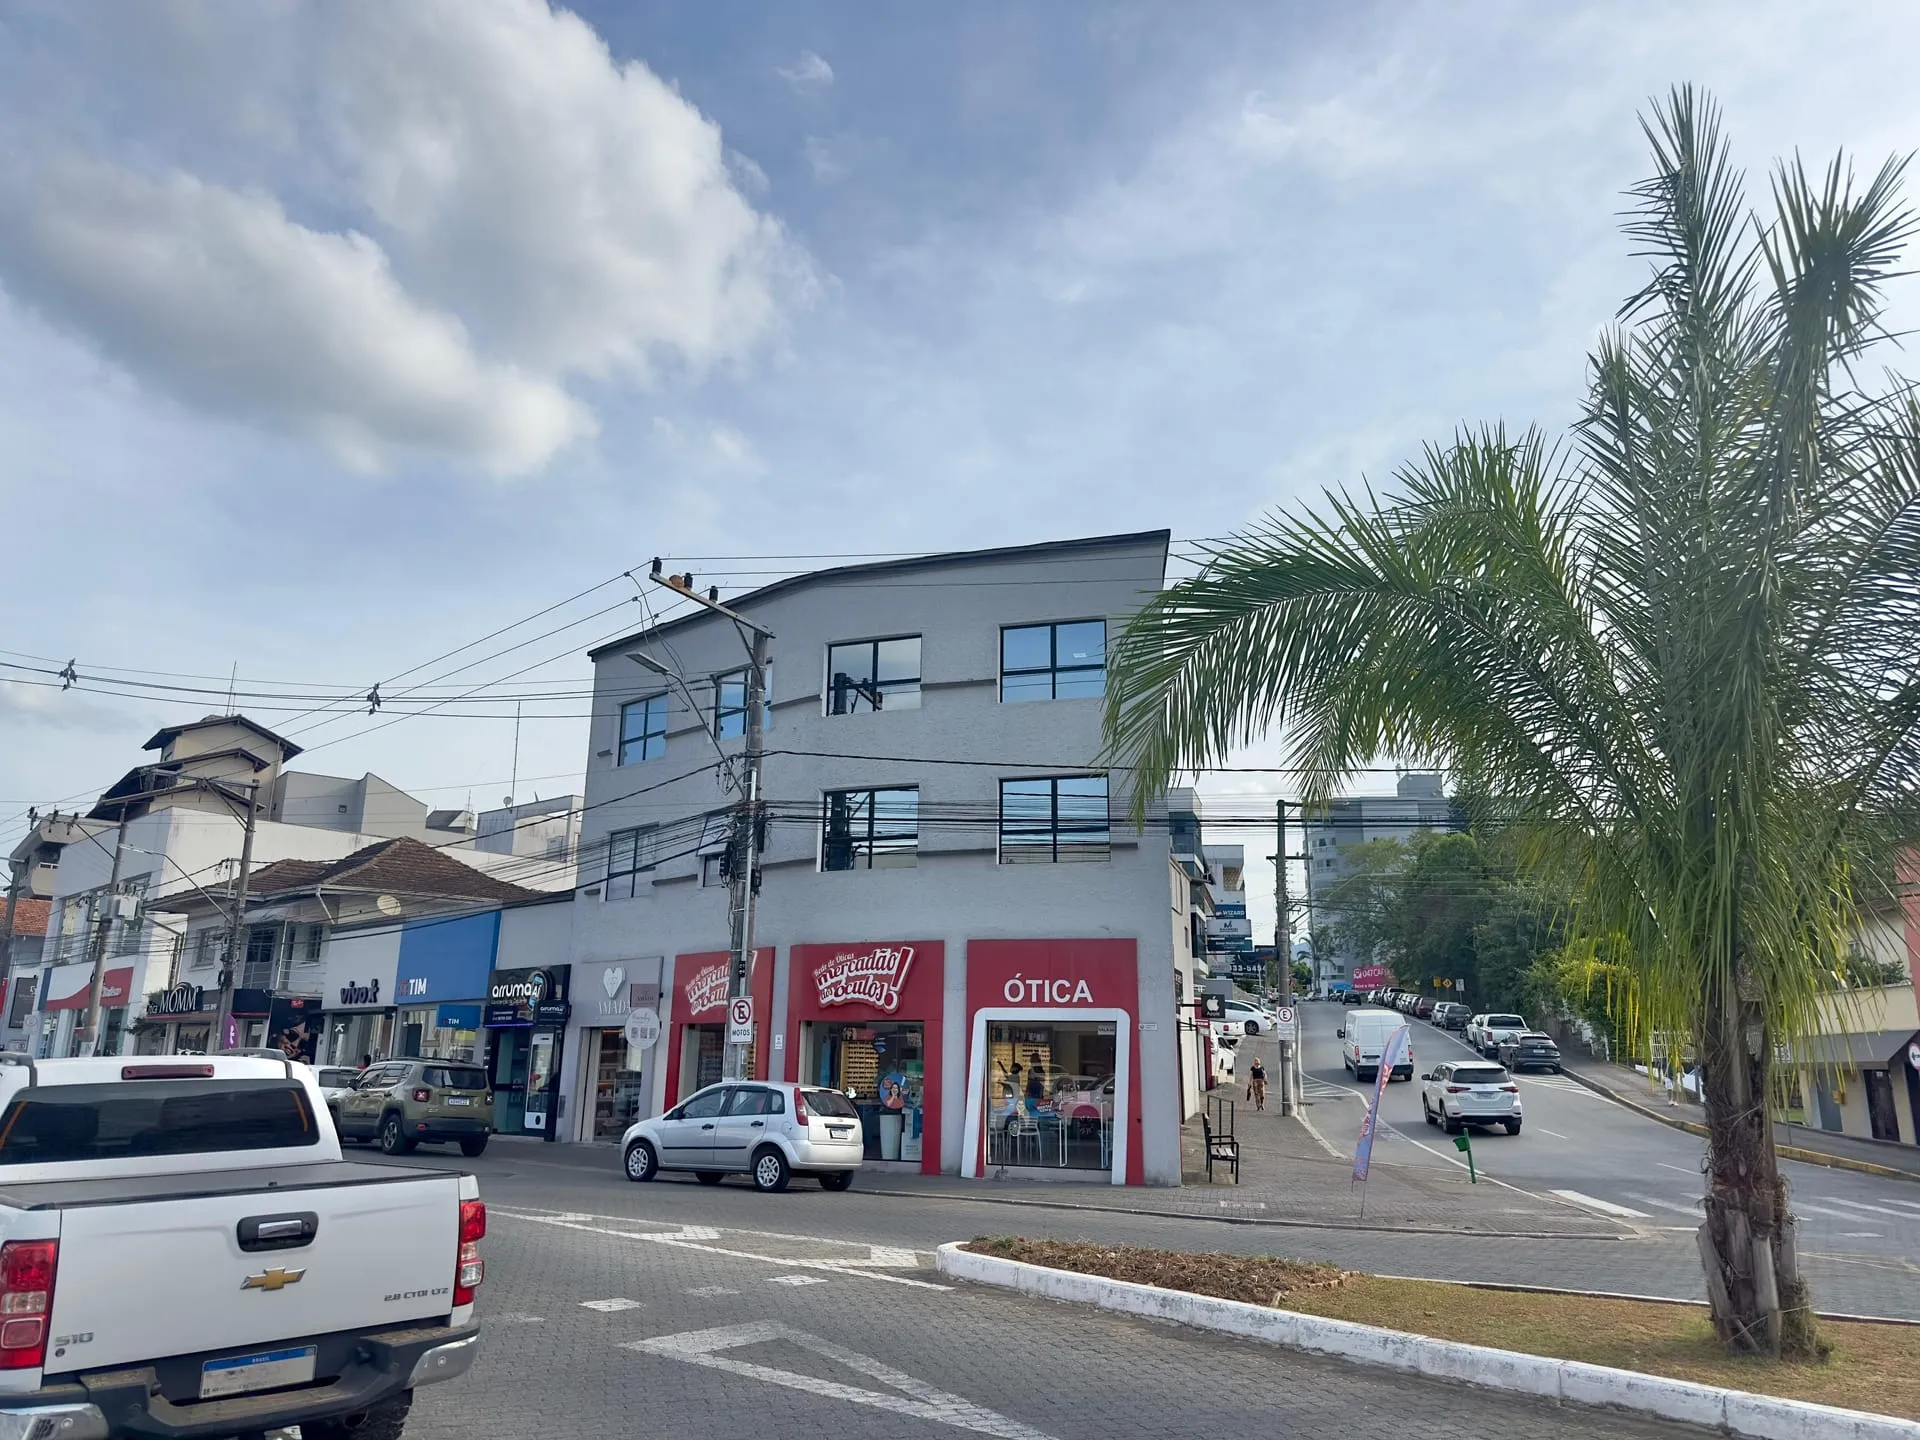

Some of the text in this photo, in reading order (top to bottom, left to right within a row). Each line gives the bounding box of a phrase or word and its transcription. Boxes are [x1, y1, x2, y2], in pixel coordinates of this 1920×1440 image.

[817, 948, 900, 988] mercadão
[341, 981, 369, 1004] vivo
[409, 978, 427, 995] TIM
[492, 983, 532, 998] arruma
[821, 987, 834, 999] dos
[1004, 973, 1094, 1003] ÓTICA
[732, 1029, 751, 1037] MOTOS
[431, 1287, 449, 1296] LTZ
[55, 1331, 94, 1347] S10
